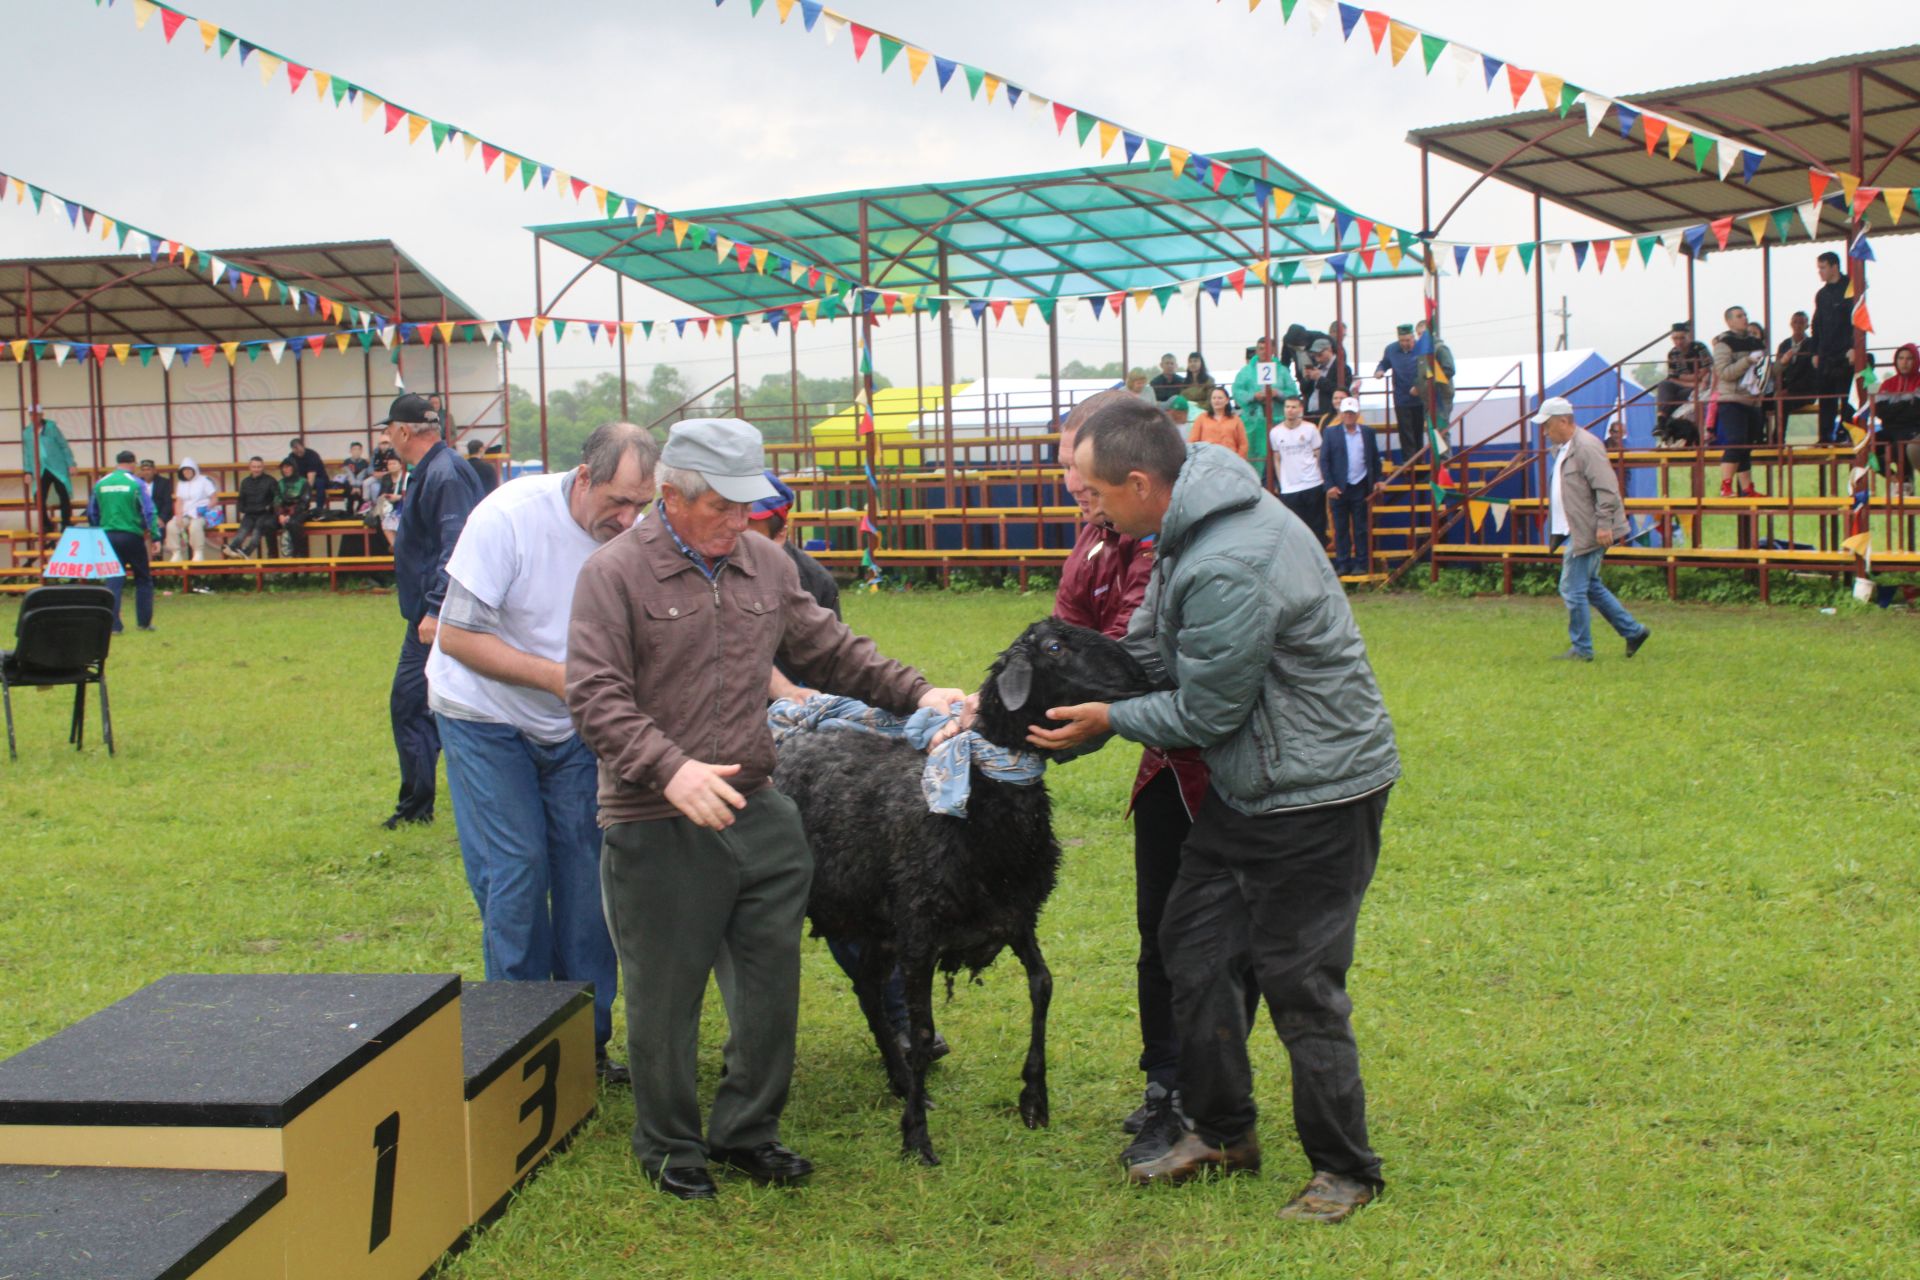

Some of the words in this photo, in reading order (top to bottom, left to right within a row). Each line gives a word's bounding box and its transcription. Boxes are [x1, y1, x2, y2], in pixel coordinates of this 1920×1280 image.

[1262, 366, 1271, 381] 2
[68, 540, 80, 557] 2
[49, 562, 93, 577] КОВЕР
[515, 1038, 561, 1174] 3
[369, 1110, 400, 1255] 1
